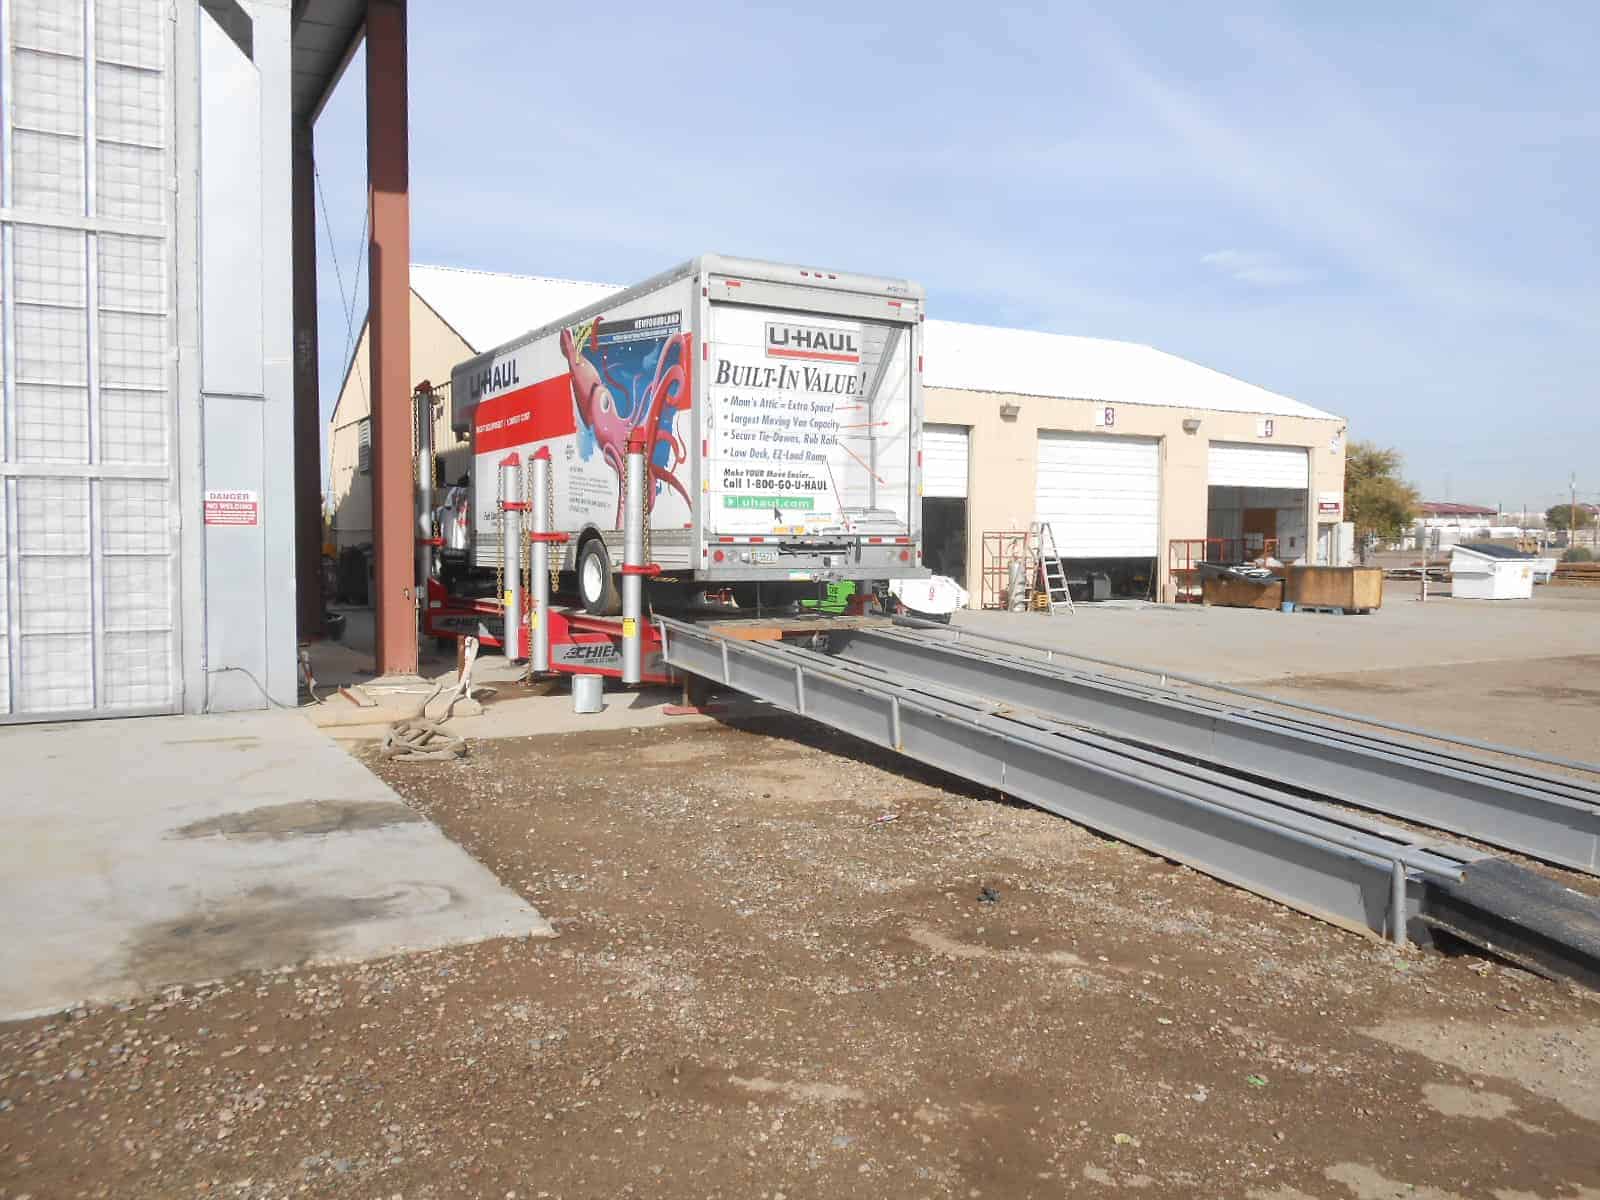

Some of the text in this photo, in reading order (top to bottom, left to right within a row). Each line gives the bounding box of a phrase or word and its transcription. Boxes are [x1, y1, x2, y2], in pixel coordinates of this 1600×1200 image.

[769, 327, 857, 352] U-HAUL
[470, 359, 519, 399] U-HAUL
[715, 359, 799, 389] BUILT-IN
[730, 396, 757, 408] Mom's
[760, 398, 778, 409] Attic
[788, 400, 808, 411] Extra
[811, 402, 834, 415] Space!
[730, 412, 840, 432] Largest Moving Van Capacity
[1106, 408, 1113, 424] 3
[730, 429, 757, 441] Secure
[803, 434, 818, 444] Rub
[820, 434, 838, 446] Rails
[730, 448, 747, 457] Low
[772, 451, 803, 462] EZ-Load
[723, 467, 744, 477] Make
[745, 469, 764, 478] YOUR
[766, 470, 786, 479] Move
[723, 478, 827, 491] Call 1-800-GO-U-HAUL
[207, 502, 253, 511] NO WELDING
[742, 497, 810, 509] uhaul.com
